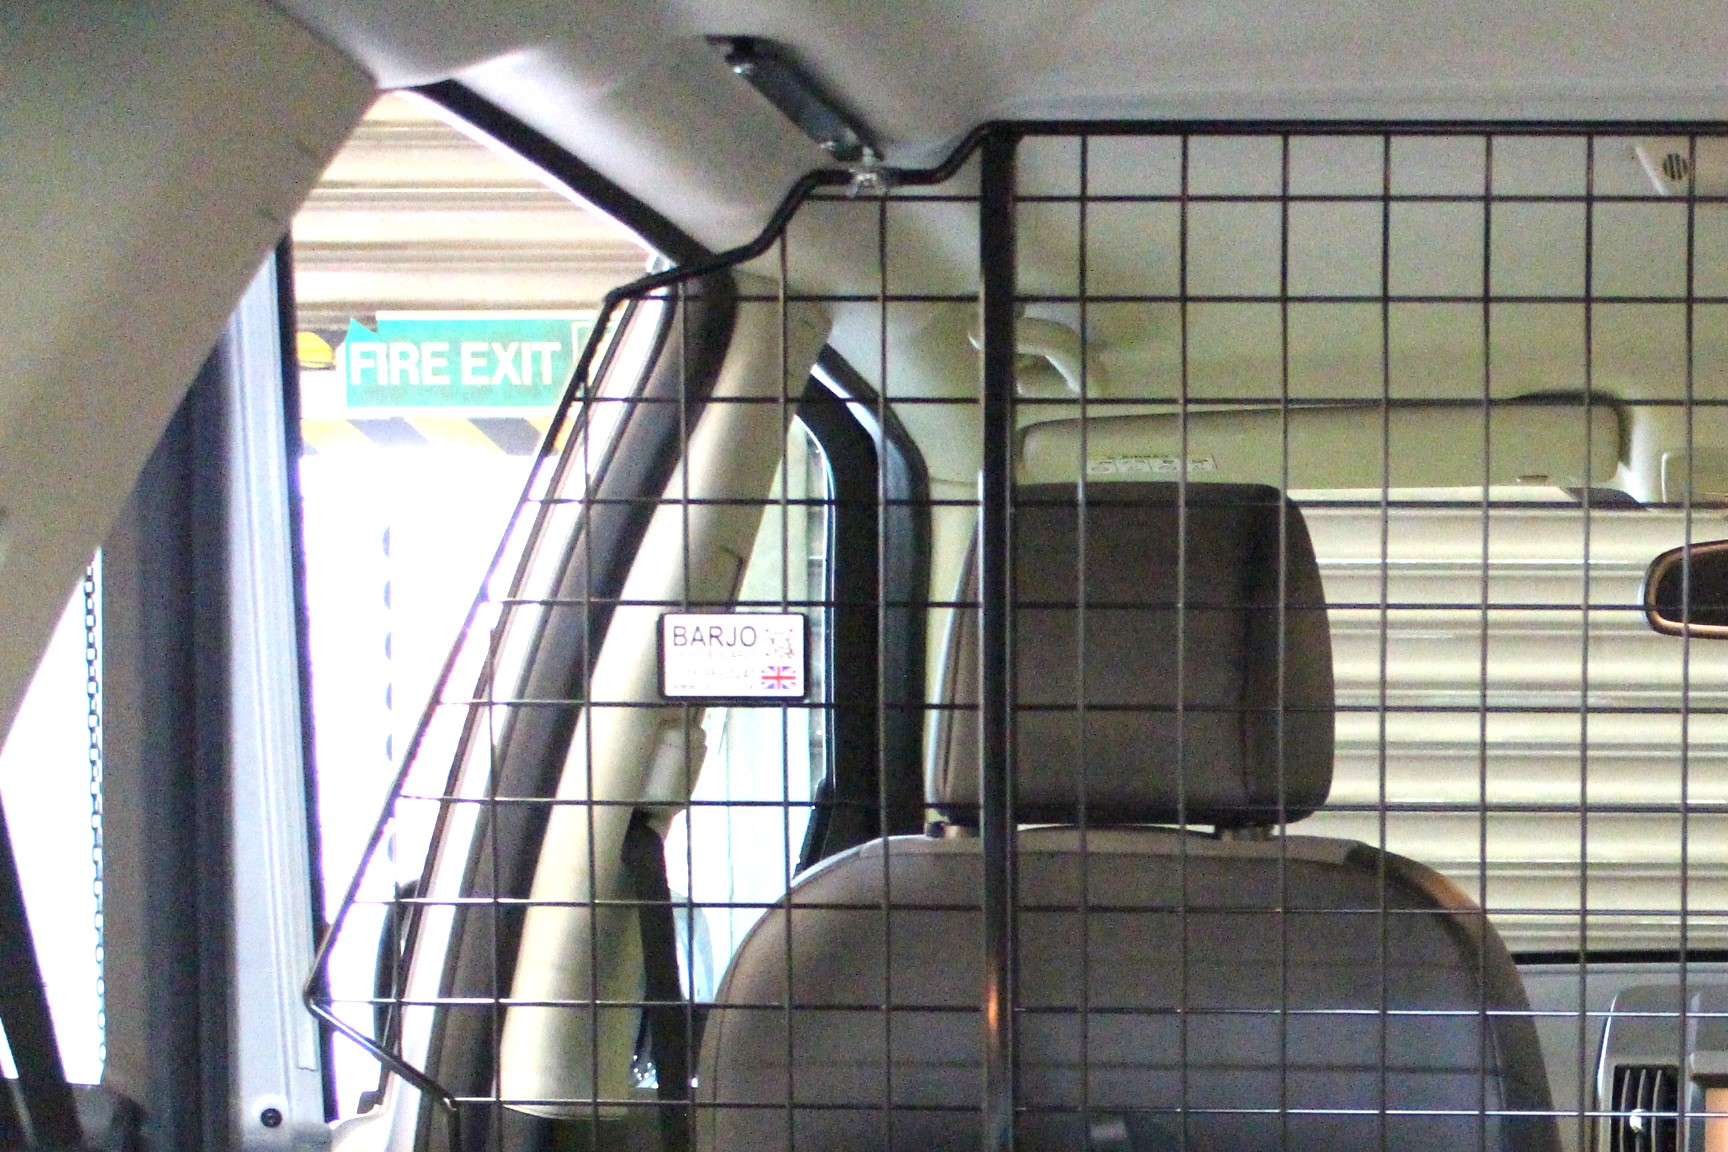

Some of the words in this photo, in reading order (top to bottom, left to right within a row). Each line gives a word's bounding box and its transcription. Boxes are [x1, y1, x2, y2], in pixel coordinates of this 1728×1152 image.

[350, 341, 450, 385] FIRE
[460, 341, 562, 385] EXIT
[673, 625, 757, 647] BARJO
